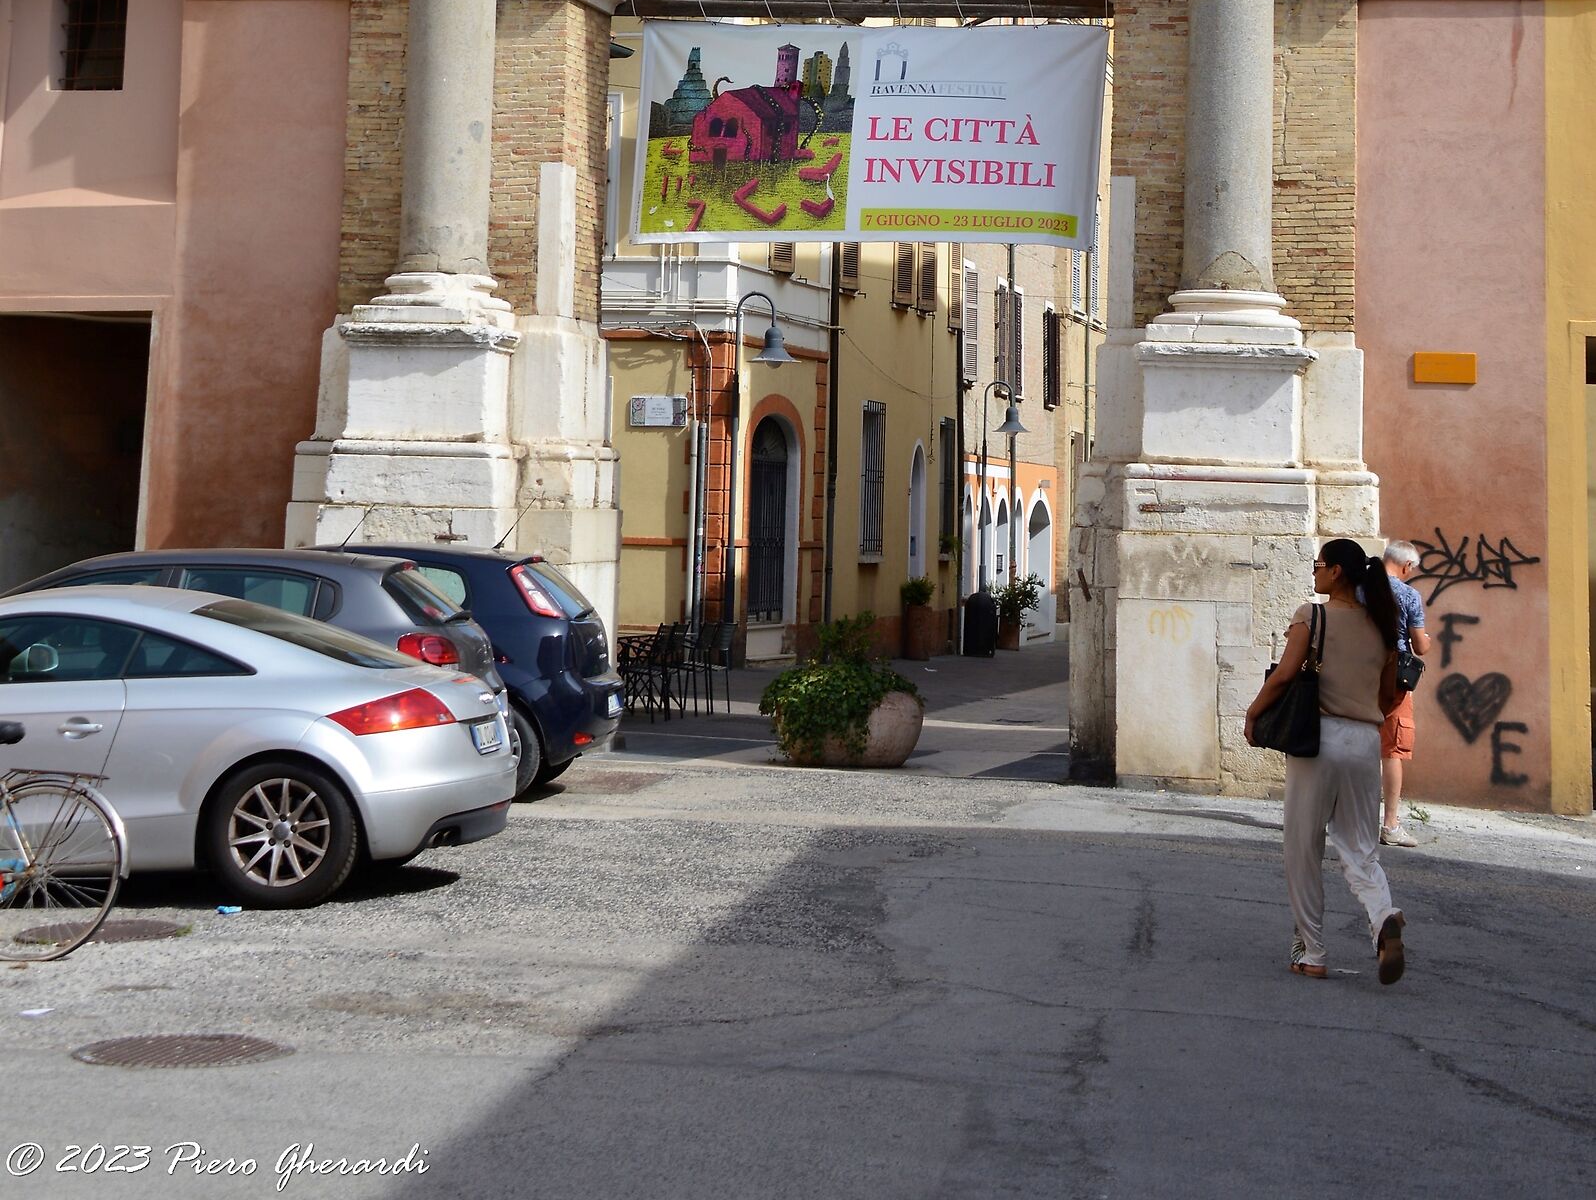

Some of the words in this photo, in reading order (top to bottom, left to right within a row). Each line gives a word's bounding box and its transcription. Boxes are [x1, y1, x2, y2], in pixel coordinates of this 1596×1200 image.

[871, 83, 937, 95] RAVENNA
[939, 83, 1007, 97] FESTIVAL
[866, 116, 913, 142] LE
[924, 113, 1041, 146] CITTÀ
[863, 157, 1057, 188] INVISIBILI
[865, 214, 873, 227] 7
[876, 214, 940, 228] GIUGNO
[953, 214, 969, 228] 23
[972, 215, 1034, 229] LUGLIO
[1037, 217, 1069, 232] 2023
[1437, 612, 1480, 669] F
[1490, 720, 1529, 787] E
